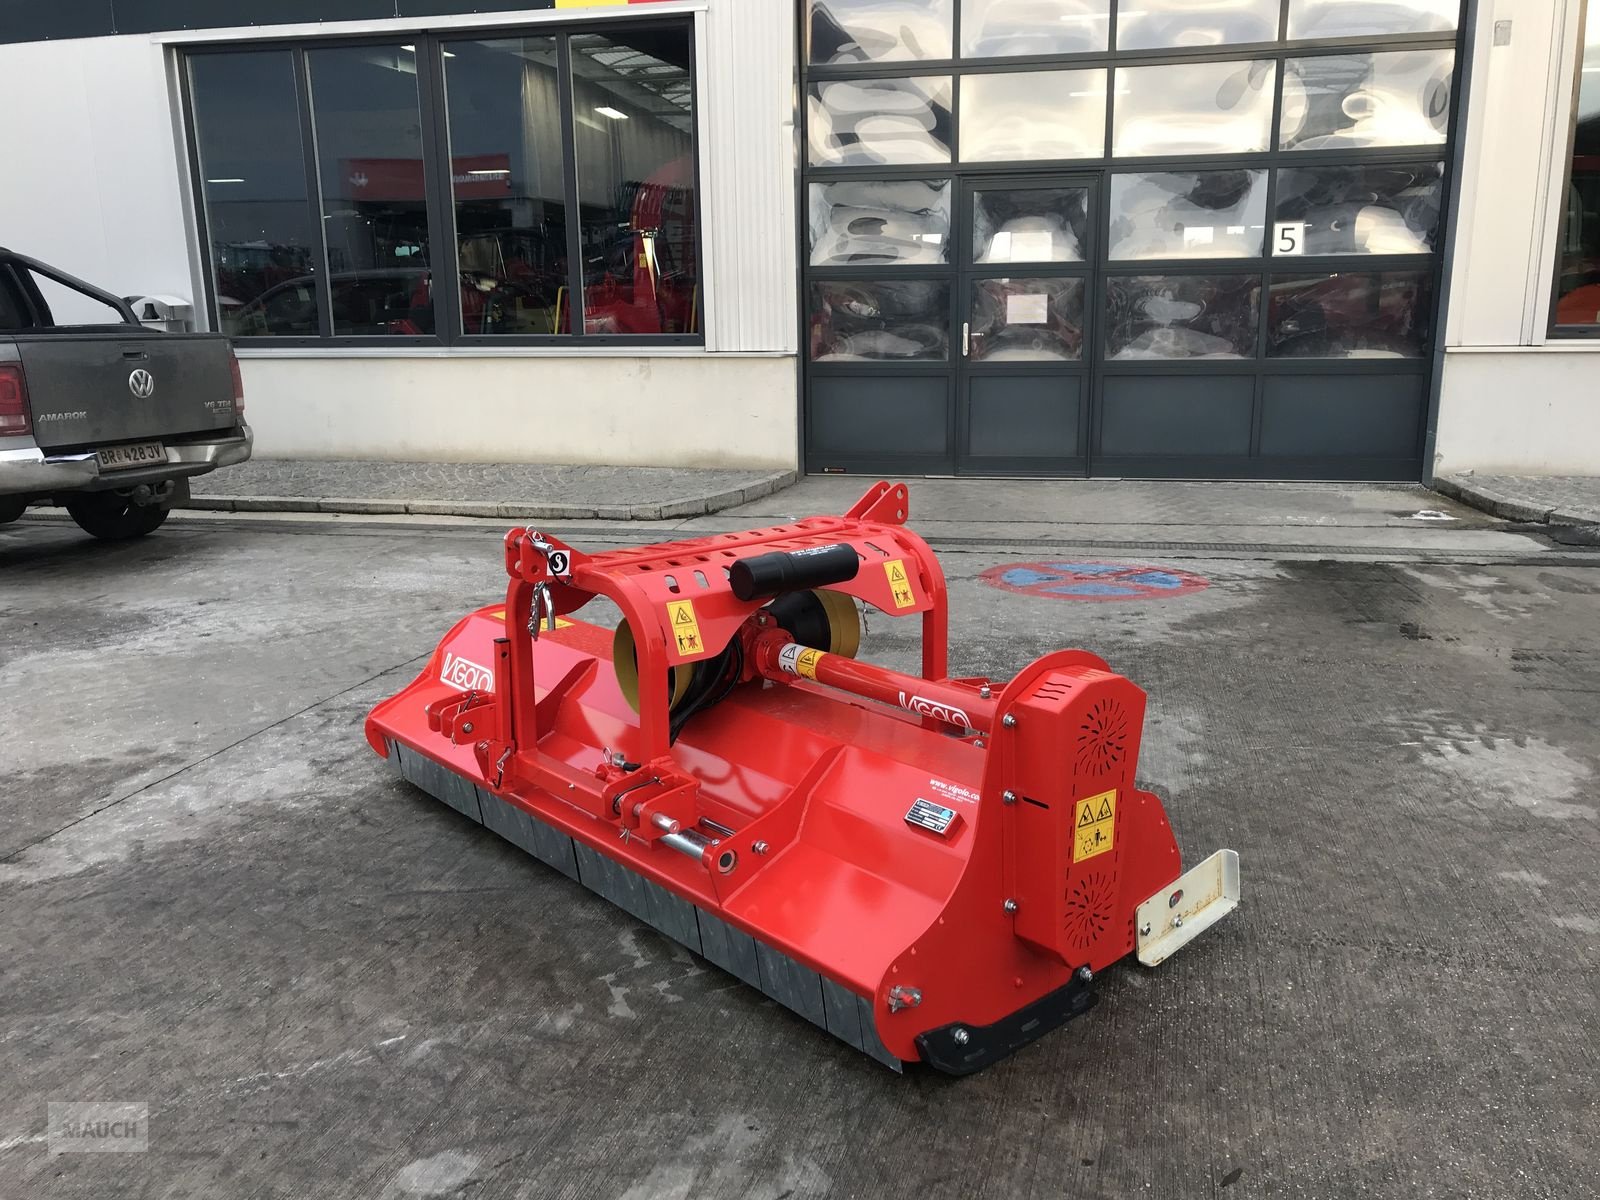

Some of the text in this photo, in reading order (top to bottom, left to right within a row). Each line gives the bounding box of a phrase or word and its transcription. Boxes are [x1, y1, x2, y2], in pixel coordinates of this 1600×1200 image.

[1279, 227, 1295, 252] 5
[38, 411, 87, 422] AMAROK
[100, 450, 117, 464] BR
[124, 447, 146, 461] 428
[440, 652, 493, 692] VIGOLO
[899, 691, 973, 729] VIGOLO
[929, 779, 980, 800] www.vigolo.co
